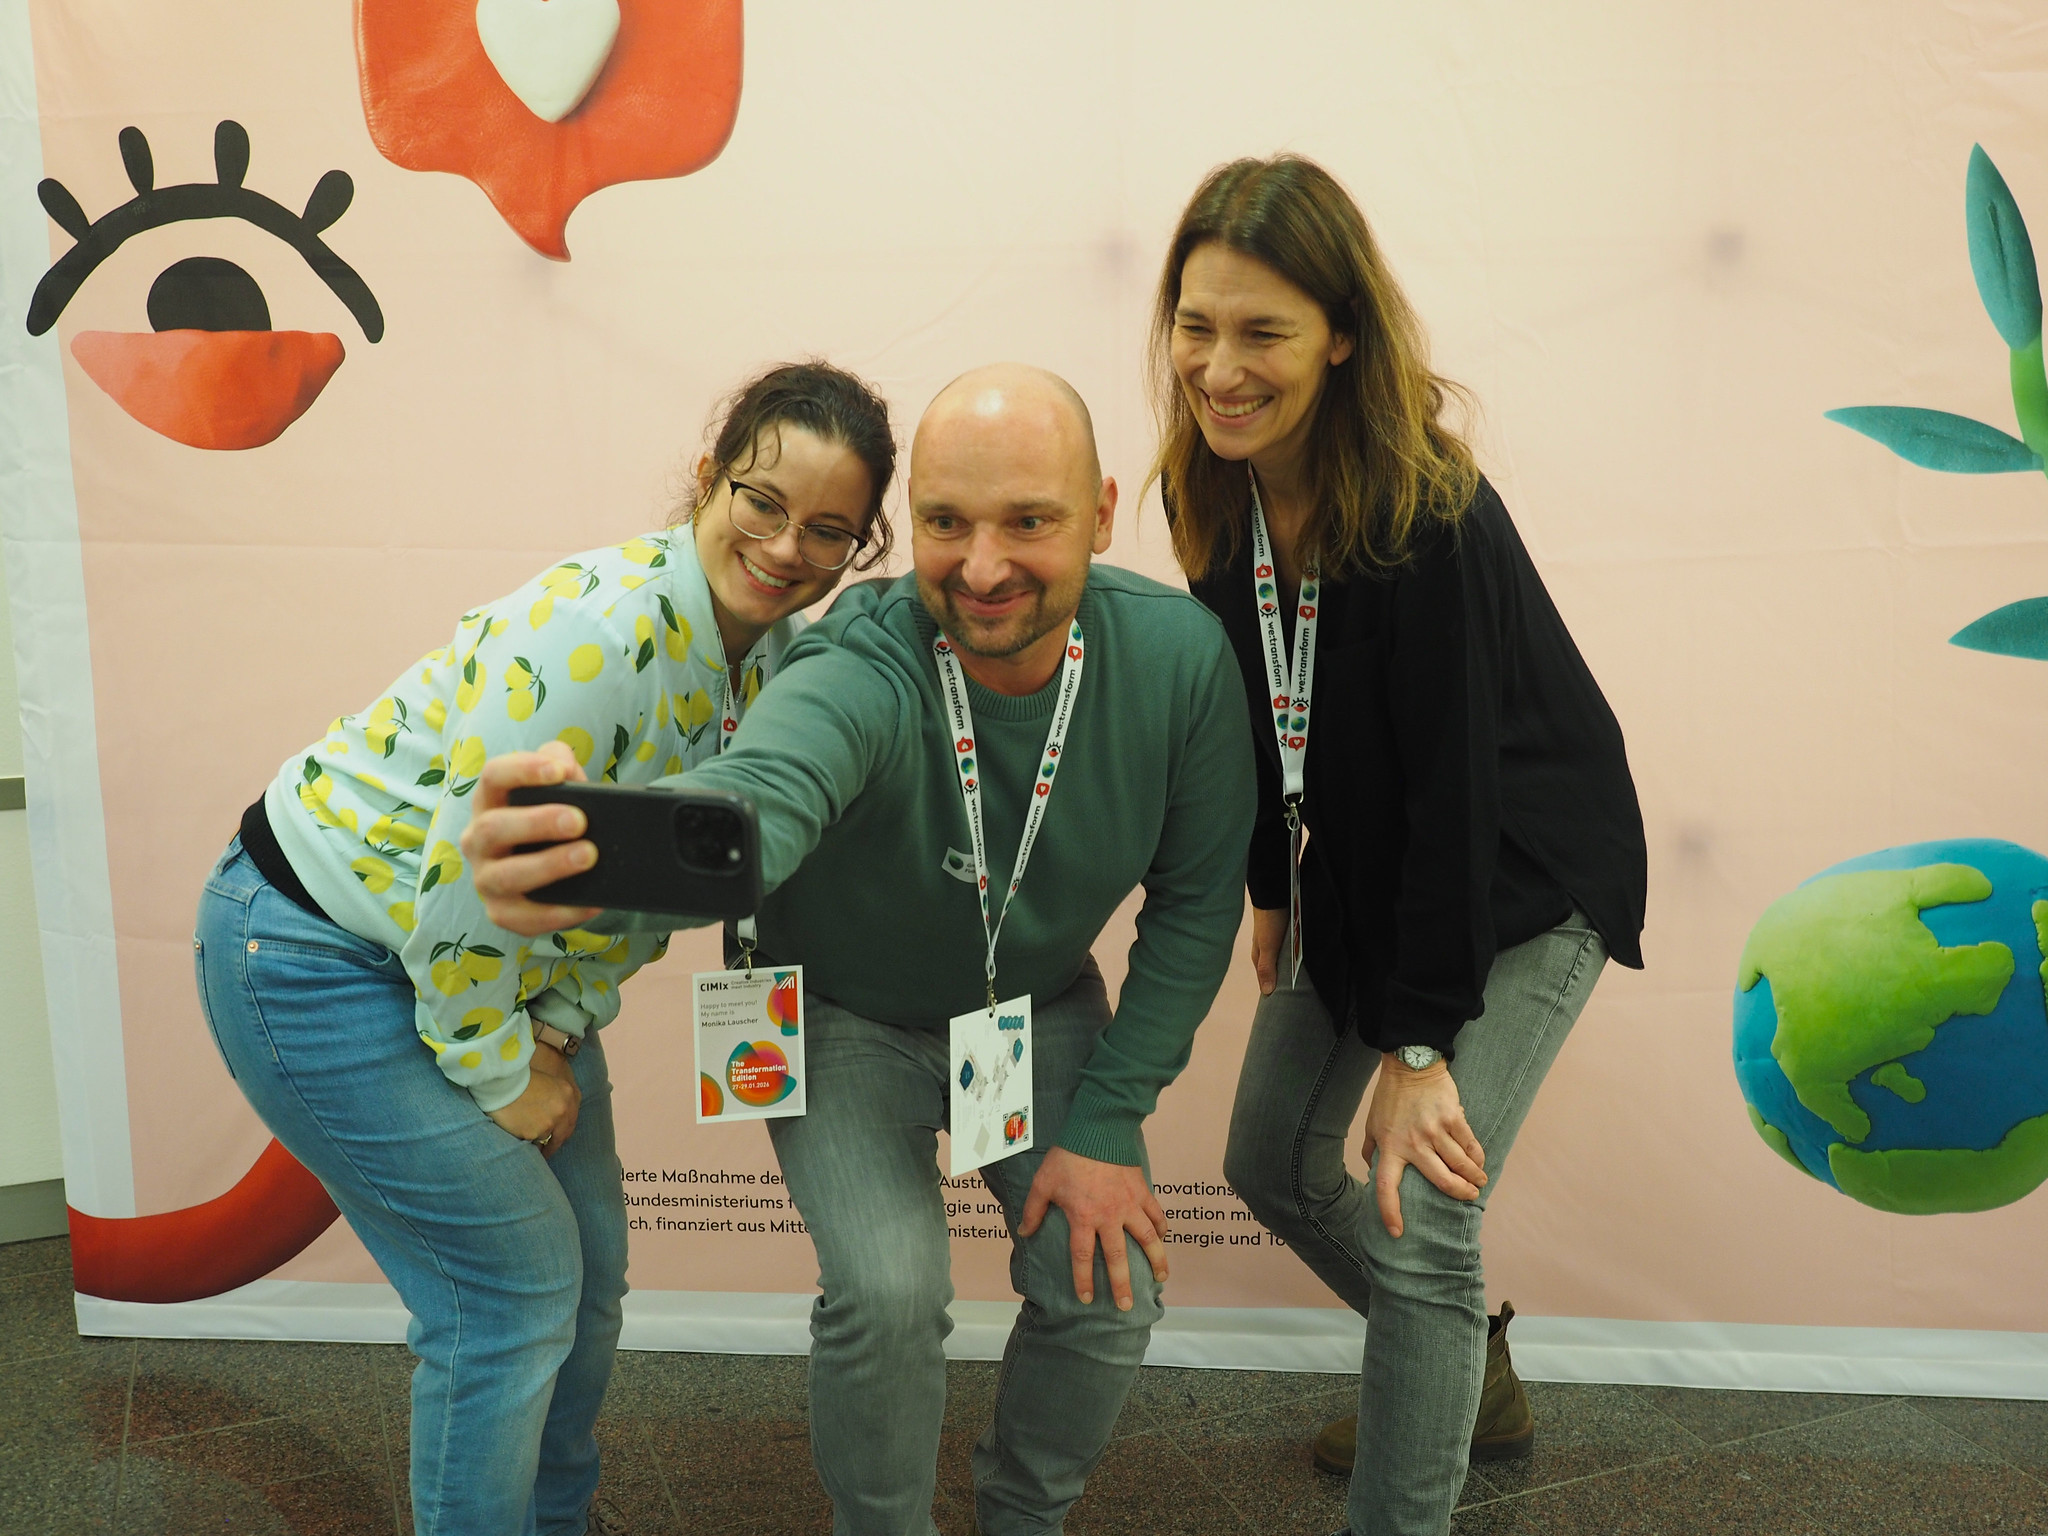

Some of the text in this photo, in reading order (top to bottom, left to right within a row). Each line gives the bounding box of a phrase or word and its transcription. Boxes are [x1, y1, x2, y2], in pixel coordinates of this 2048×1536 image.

[1267, 621, 1283, 689] we:transform
[1297, 627, 1310, 694] we:transform
[944, 659, 965, 730] we:transform
[1055, 668, 1077, 738] we:transform
[970, 798, 984, 868] we:transform
[1018, 805, 1042, 873] we:transform
[700, 982, 729, 992] CIMIx
[701, 1017, 758, 1028] Monika Lauscher
[732, 1064, 787, 1075] Transformation
[732, 1074, 757, 1082] Edition
[662, 1168, 756, 1184] Maßnahme
[1152, 1181, 1239, 1200] novations
[1162, 1206, 1225, 1221] eration
[656, 1216, 733, 1232] finanziert
[737, 1222, 766, 1232] aus
[1229, 1232, 1261, 1246] und
